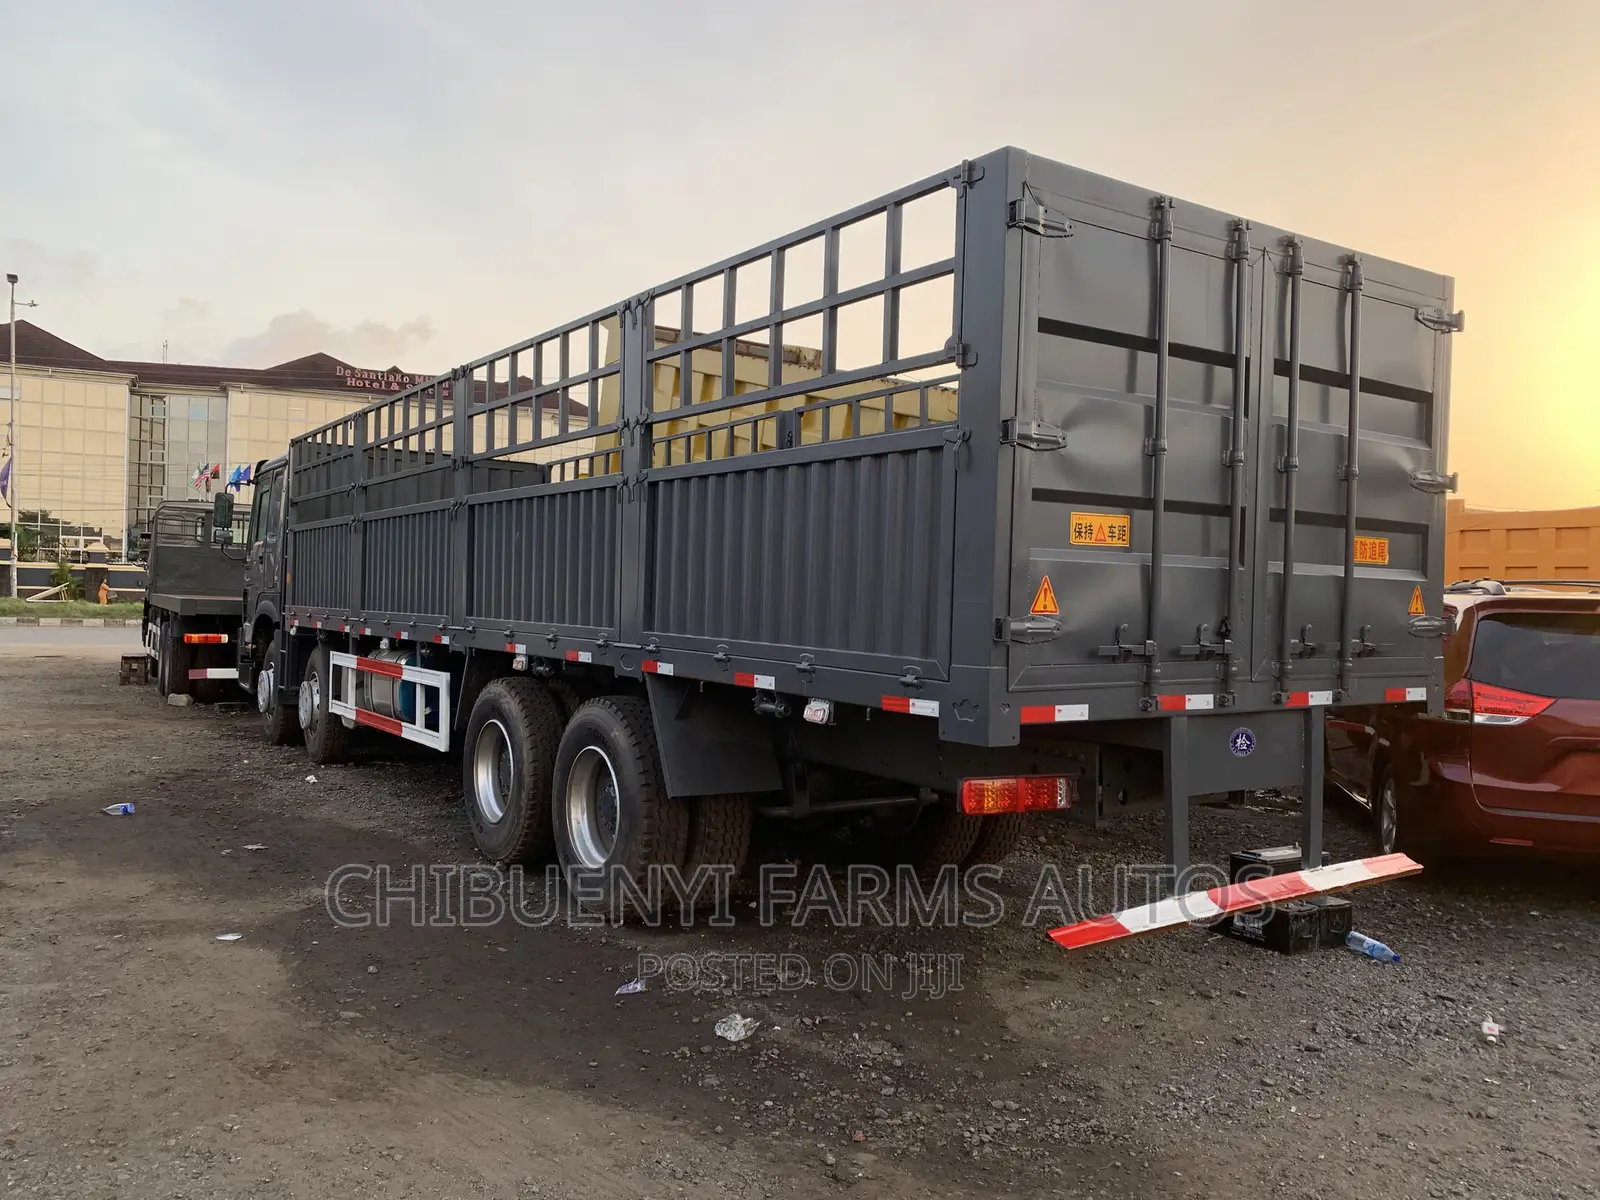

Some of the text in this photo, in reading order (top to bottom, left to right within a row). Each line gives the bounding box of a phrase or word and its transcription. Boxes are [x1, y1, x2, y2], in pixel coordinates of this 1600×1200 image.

[346, 377, 386, 389] Hotel
[390, 382, 400, 391] &
[1073, 522, 1127, 542] 保持 车距
